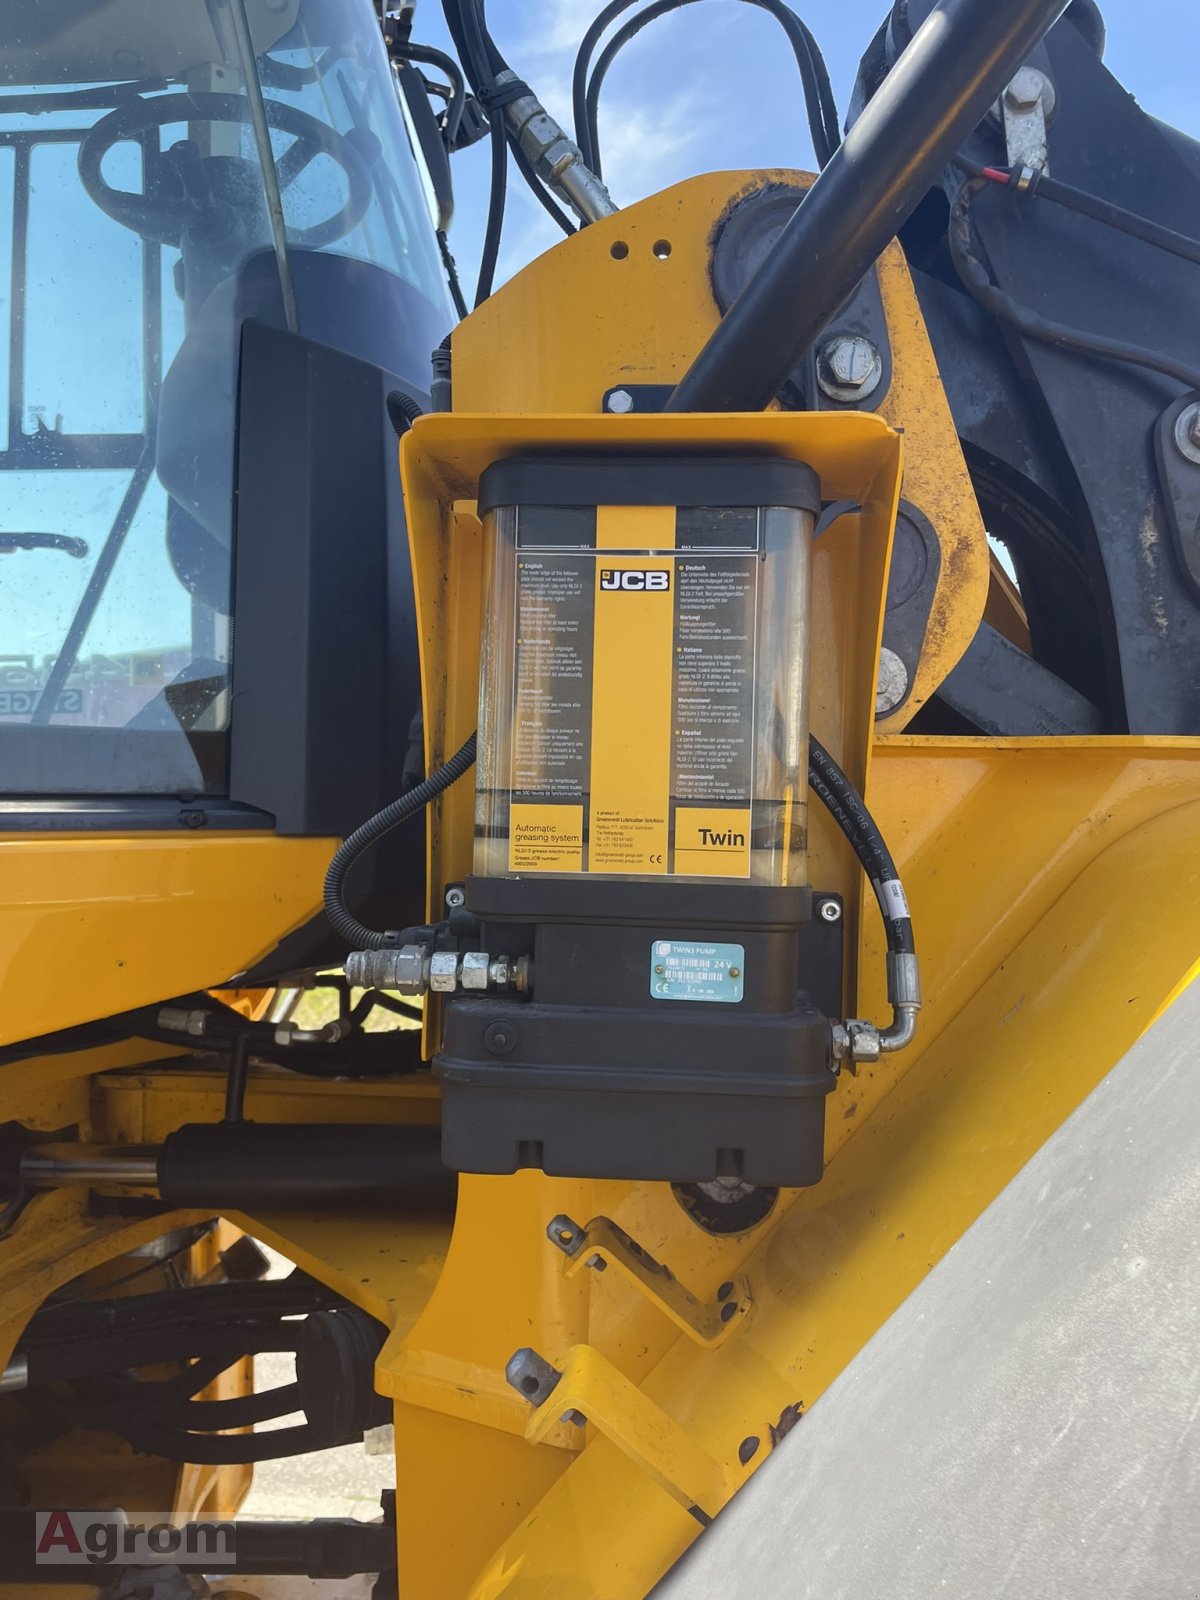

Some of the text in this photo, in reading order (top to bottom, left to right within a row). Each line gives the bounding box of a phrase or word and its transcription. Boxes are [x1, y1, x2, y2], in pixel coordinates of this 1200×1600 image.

[602, 571, 668, 590] JCB
[813, 750, 826, 764] EN
[826, 768, 844, 785] 857
[515, 824, 556, 832] Automatic
[515, 834, 579, 843] greasing system
[698, 829, 744, 846] Twin
